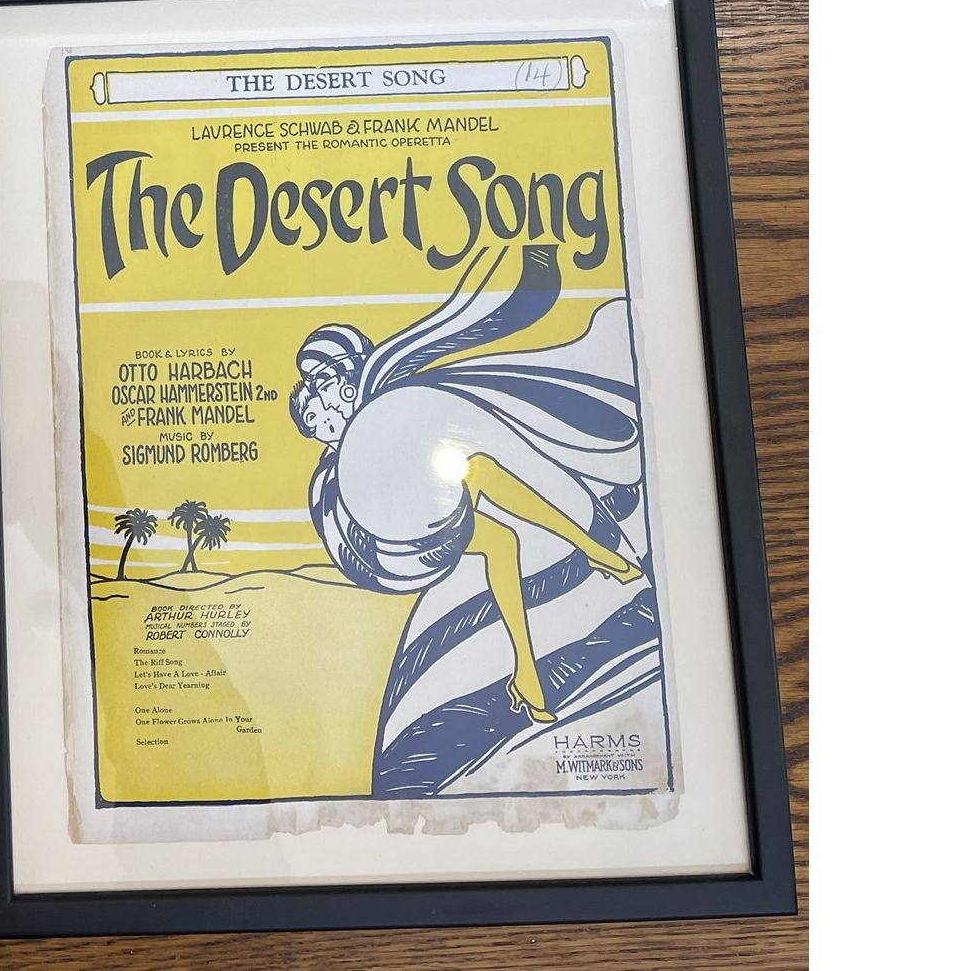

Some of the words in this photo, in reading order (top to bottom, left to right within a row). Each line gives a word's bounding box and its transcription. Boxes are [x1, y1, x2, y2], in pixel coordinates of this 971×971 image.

[226, 74, 275, 93] THE
[285, 70, 373, 92] DESERT
[382, 68, 447, 89] SONG
[279, 119, 344, 137] SCHWAB
[346, 119, 361, 135] &
[363, 117, 421, 135] FRANK
[425, 115, 500, 134] MANDEL
[234, 141, 289, 153] PRESENT
[295, 139, 319, 151] THE
[322, 138, 388, 150] ROMANTIC
[391, 136, 451, 148] OPERETTA
[85, 149, 204, 281] The
[214, 156, 432, 276] Desert
[425, 155, 610, 271] Song
[135, 349, 163, 360] BOOK
[164, 349, 173, 358] &
[176, 348, 213, 358] LYRICS
[221, 347, 237, 357] BY
[118, 362, 158, 383] OTTO
[168, 359, 253, 382] HARBACH
[111, 384, 157, 406] OSCAR
[159, 381, 254, 404] HAMMERSTEIN
[138, 406, 187, 427] FRANK
[191, 404, 256, 425] MANDEL
[159, 431, 193, 442] MUSIC
[200, 431, 215, 441] BY
[122, 443, 186, 466] SIGMUND
[191, 440, 259, 464] ROMBERG
[144, 611, 194, 624] ARTHUR
[199, 609, 251, 620] HURLEY
[146, 630, 187, 641] ROBERT
[194, 628, 251, 640] CONNOLLY
[134, 659, 148, 667] The
[165, 659, 183, 667] Song
[553, 734, 641, 749] HARMS
